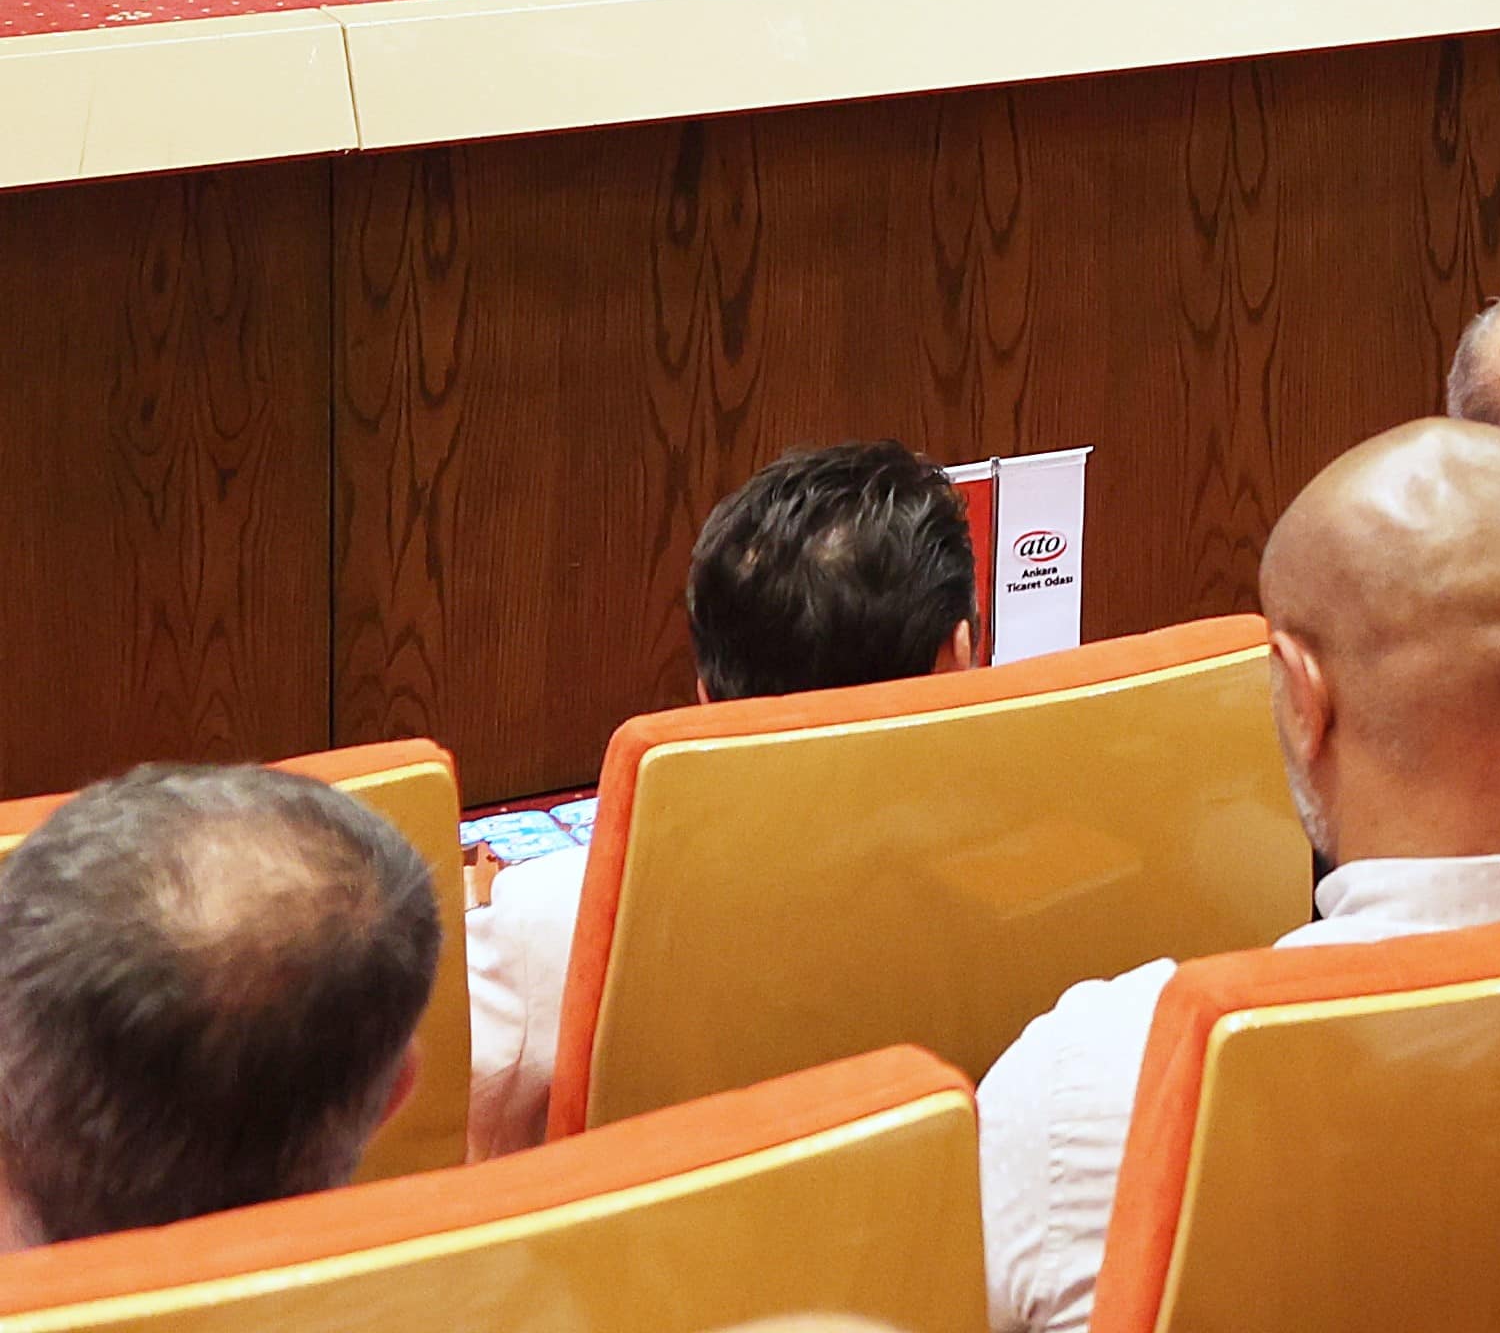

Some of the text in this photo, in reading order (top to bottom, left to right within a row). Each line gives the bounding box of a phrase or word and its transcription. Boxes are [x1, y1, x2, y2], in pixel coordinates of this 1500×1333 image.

[1020, 535, 1060, 556] ato
[1022, 566, 1058, 579] Ankara
[1006, 580, 1041, 593] Ticaret
